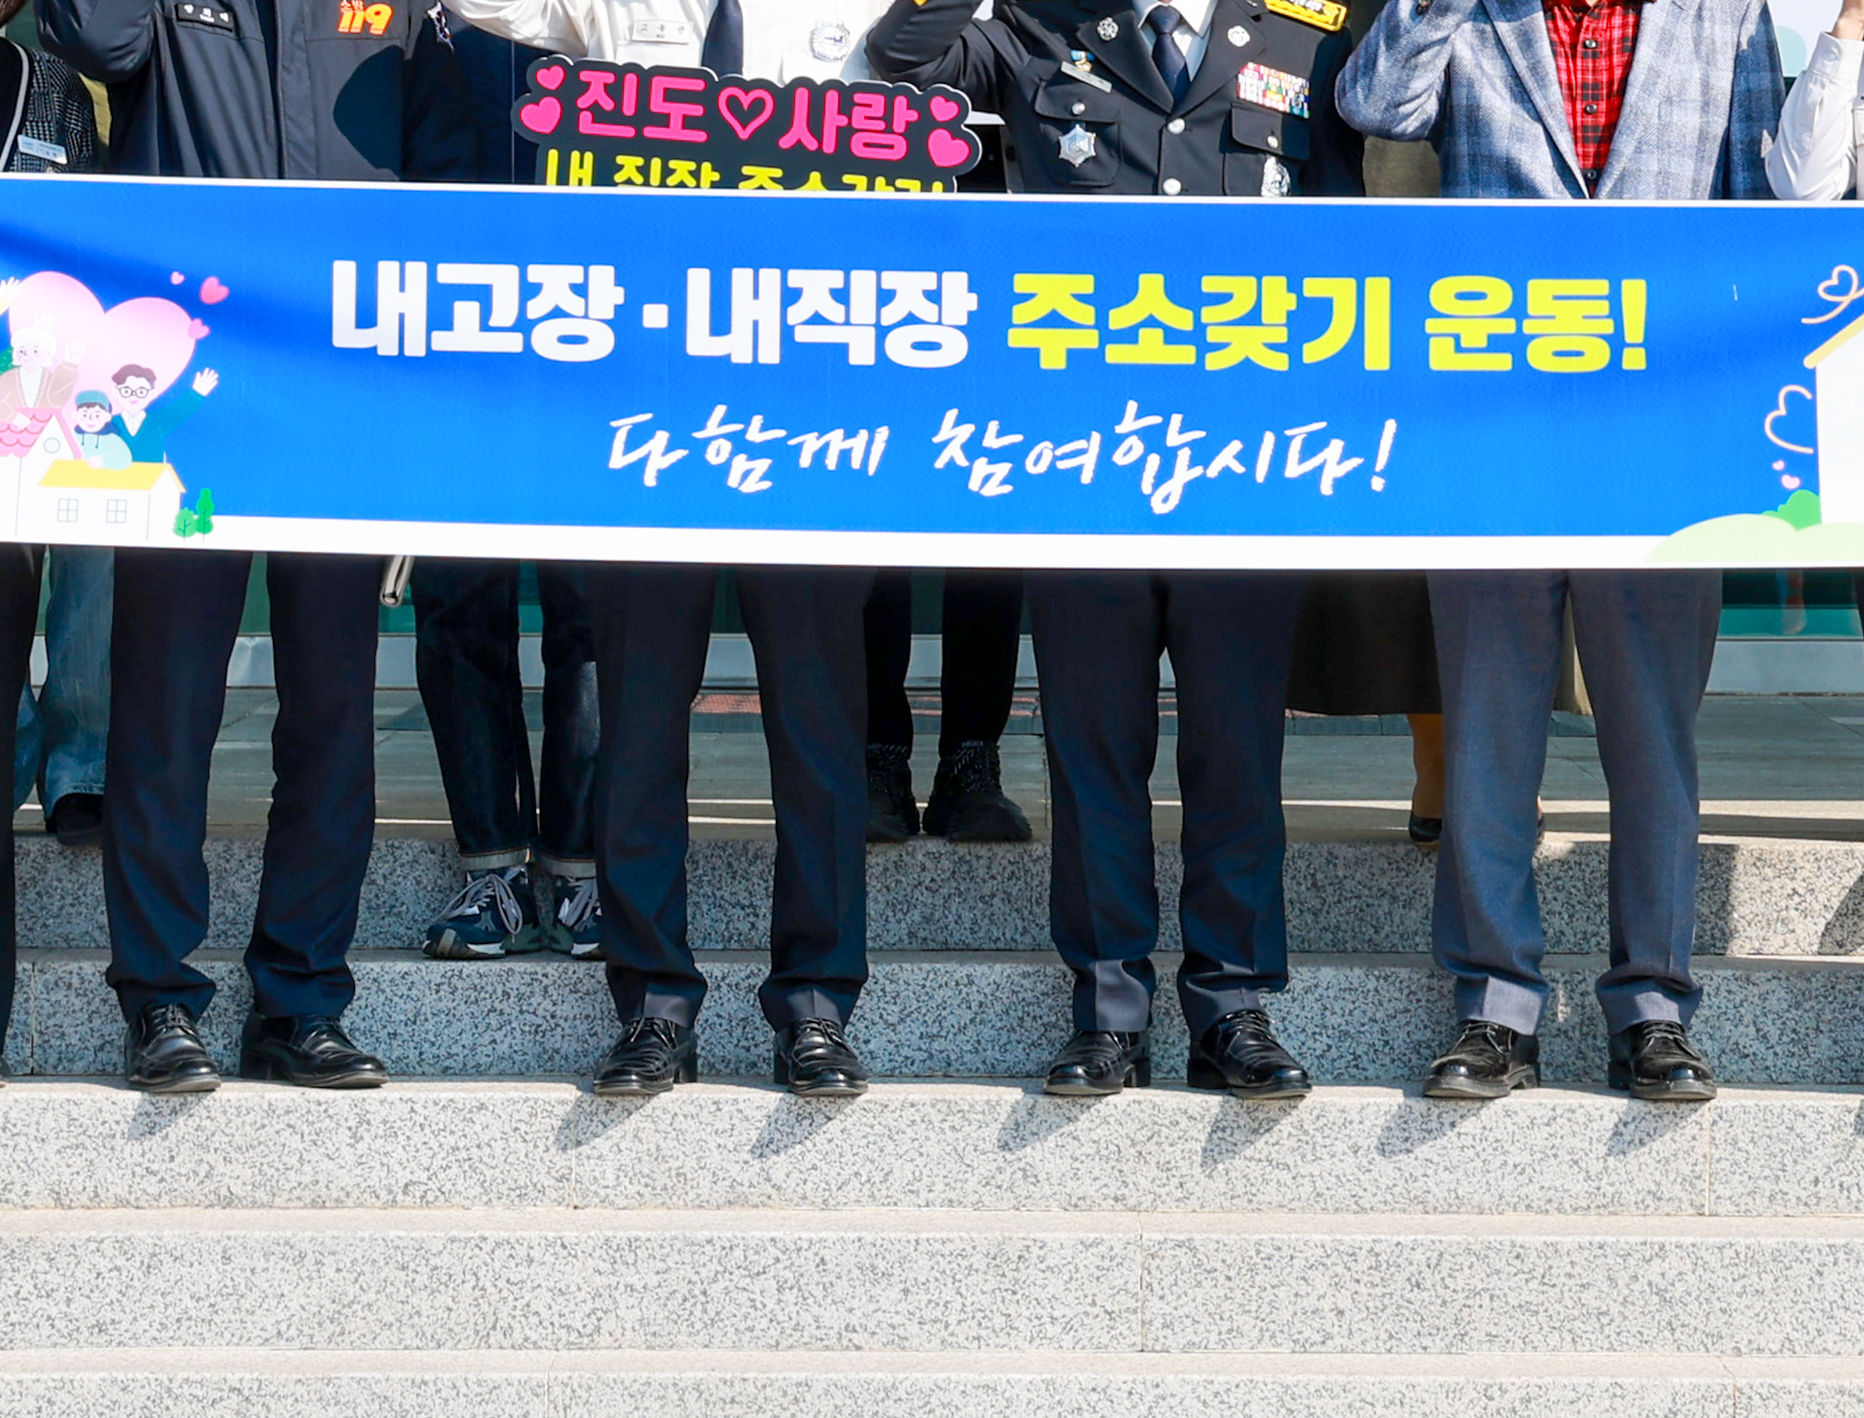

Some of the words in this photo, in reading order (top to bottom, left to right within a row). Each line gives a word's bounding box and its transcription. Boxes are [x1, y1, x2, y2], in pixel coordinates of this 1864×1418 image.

[337, 2, 395, 37] 119
[576, 69, 709, 144] 진도
[777, 86, 921, 162] 사랑
[1007, 272, 1392, 372] 주소갖기
[1424, 274, 1648, 374] 운동!
[930, 400, 1398, 515] 참여합시다!
